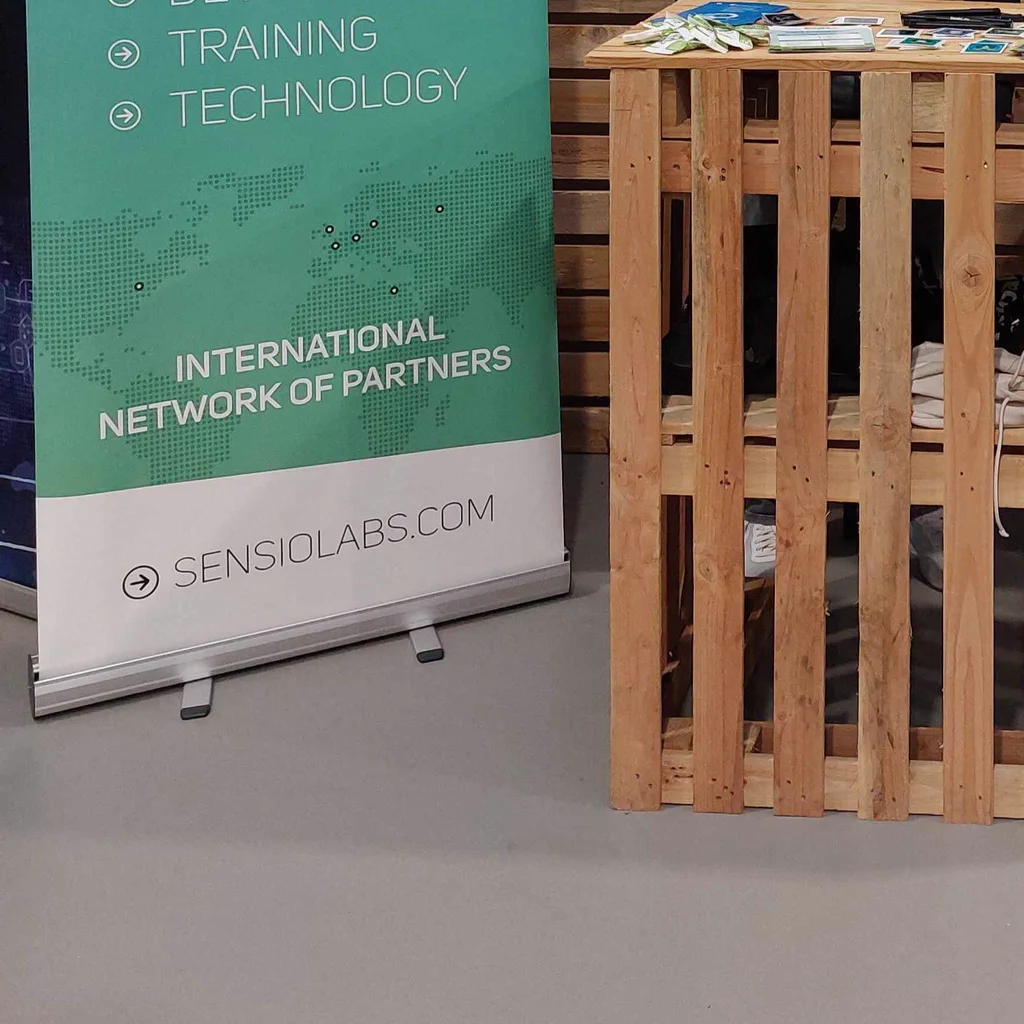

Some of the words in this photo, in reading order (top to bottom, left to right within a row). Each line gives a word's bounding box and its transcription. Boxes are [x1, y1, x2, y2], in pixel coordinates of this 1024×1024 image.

[168, 17, 376, 66] TRAINING
[170, 66, 468, 127] TECHNOLOGY
[176, 315, 446, 381] INTERNATIONAL
[99, 382, 281, 440] NETWORK
[290, 374, 333, 404] OF
[342, 345, 511, 396] PARTNERS
[174, 494, 495, 588] SENSIOLABS.COM
